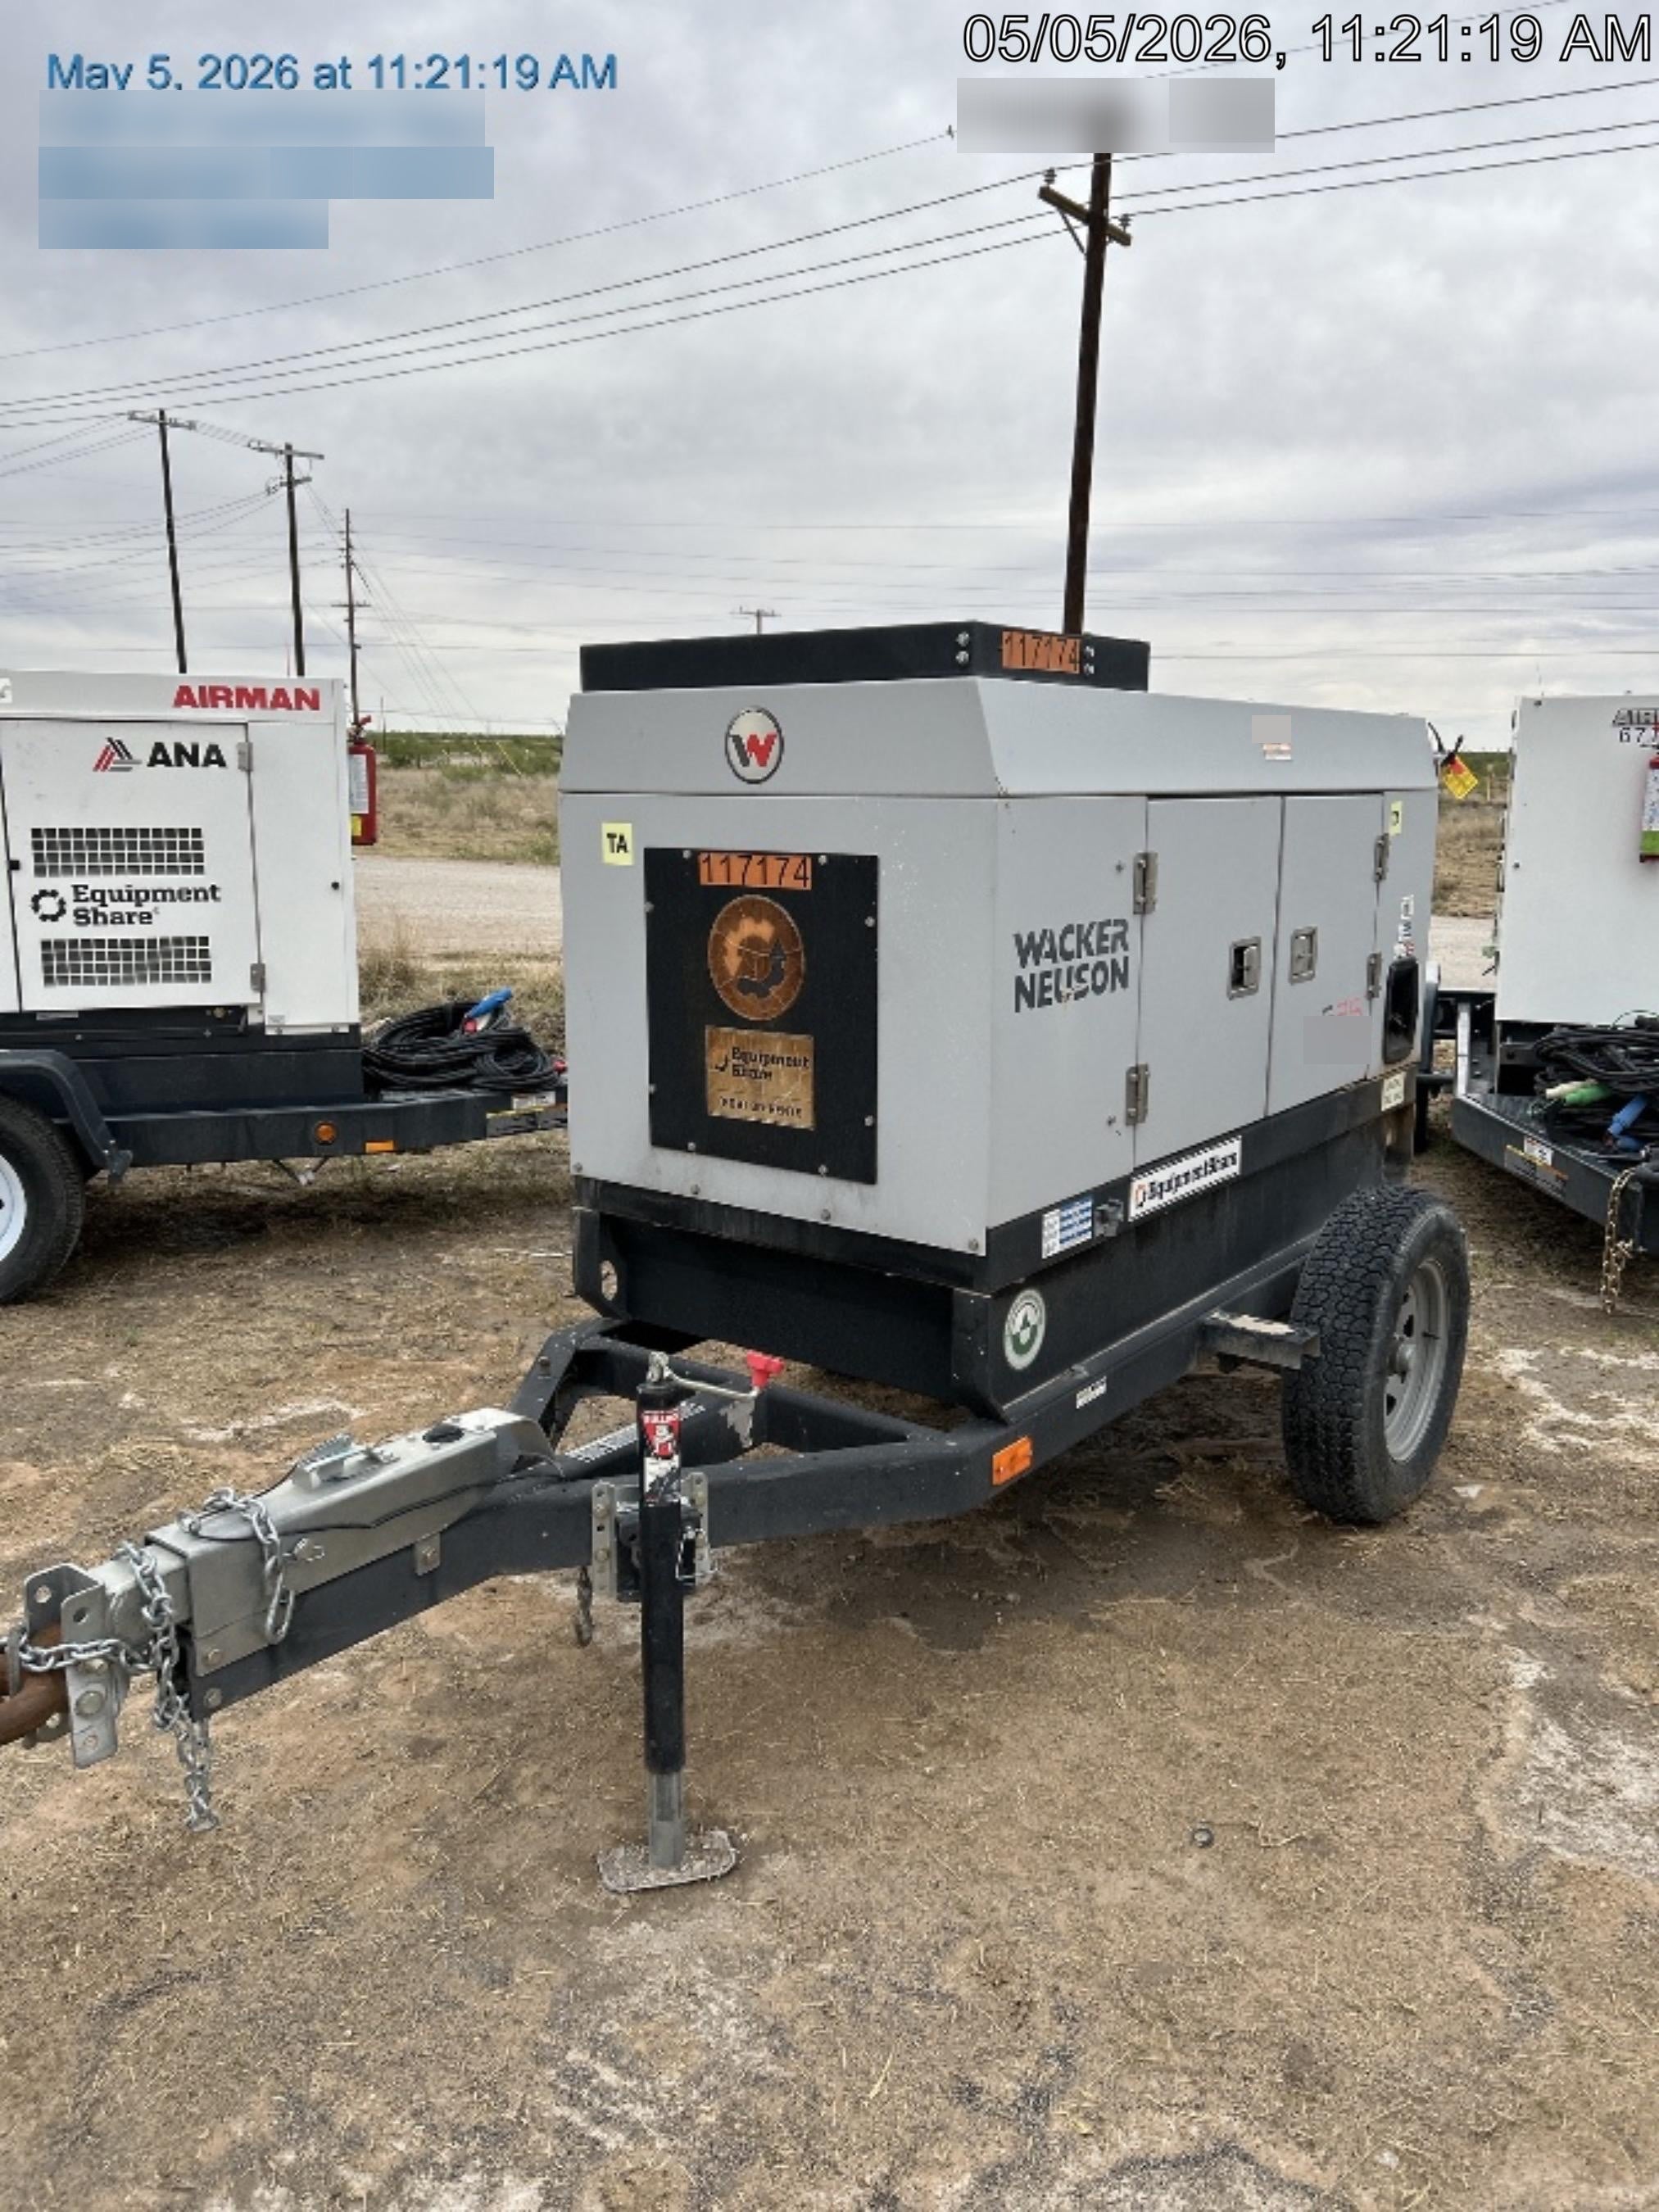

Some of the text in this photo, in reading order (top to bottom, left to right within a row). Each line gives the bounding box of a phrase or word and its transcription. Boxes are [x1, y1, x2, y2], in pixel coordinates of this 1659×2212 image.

[174, 685, 320, 710] AIRMAN
[147, 742, 227, 768] ANA
[606, 832, 628, 854] TA
[702, 854, 810, 887] 117174
[71, 884, 221, 907] Equipment
[72, 907, 153, 927] Share
[1013, 918, 1129, 968] WACKER
[1014, 955, 1129, 1013] NEUSON
